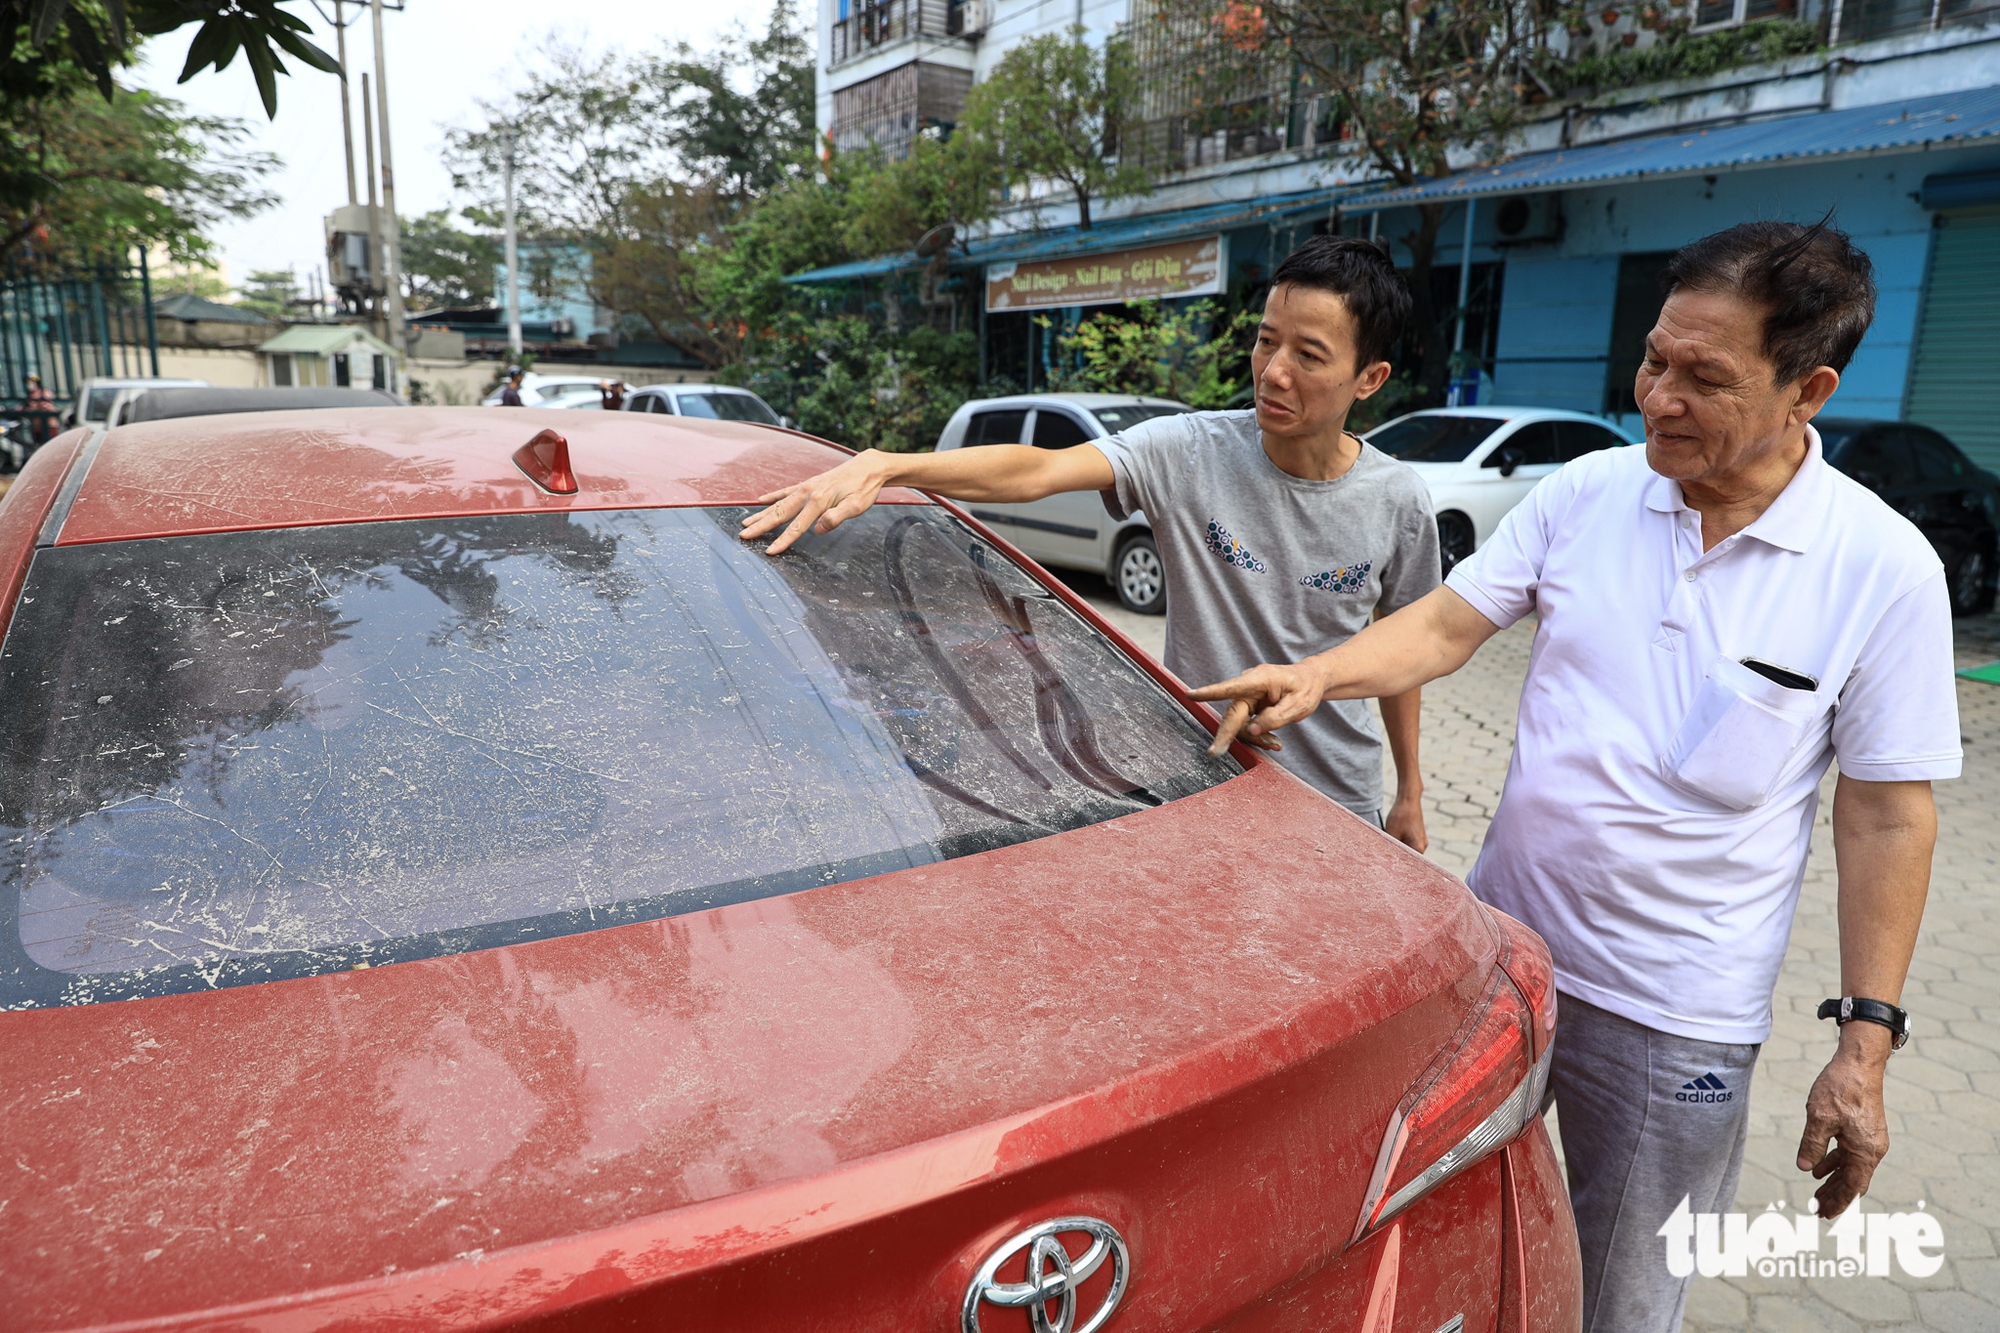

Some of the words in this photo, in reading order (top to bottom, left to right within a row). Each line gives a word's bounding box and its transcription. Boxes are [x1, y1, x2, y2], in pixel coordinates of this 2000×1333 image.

[1011, 273, 1032, 293] Nail
[1033, 270, 1068, 293] Design
[1076, 266, 1099, 286] Nail
[1675, 1090, 1732, 1103] adidas
